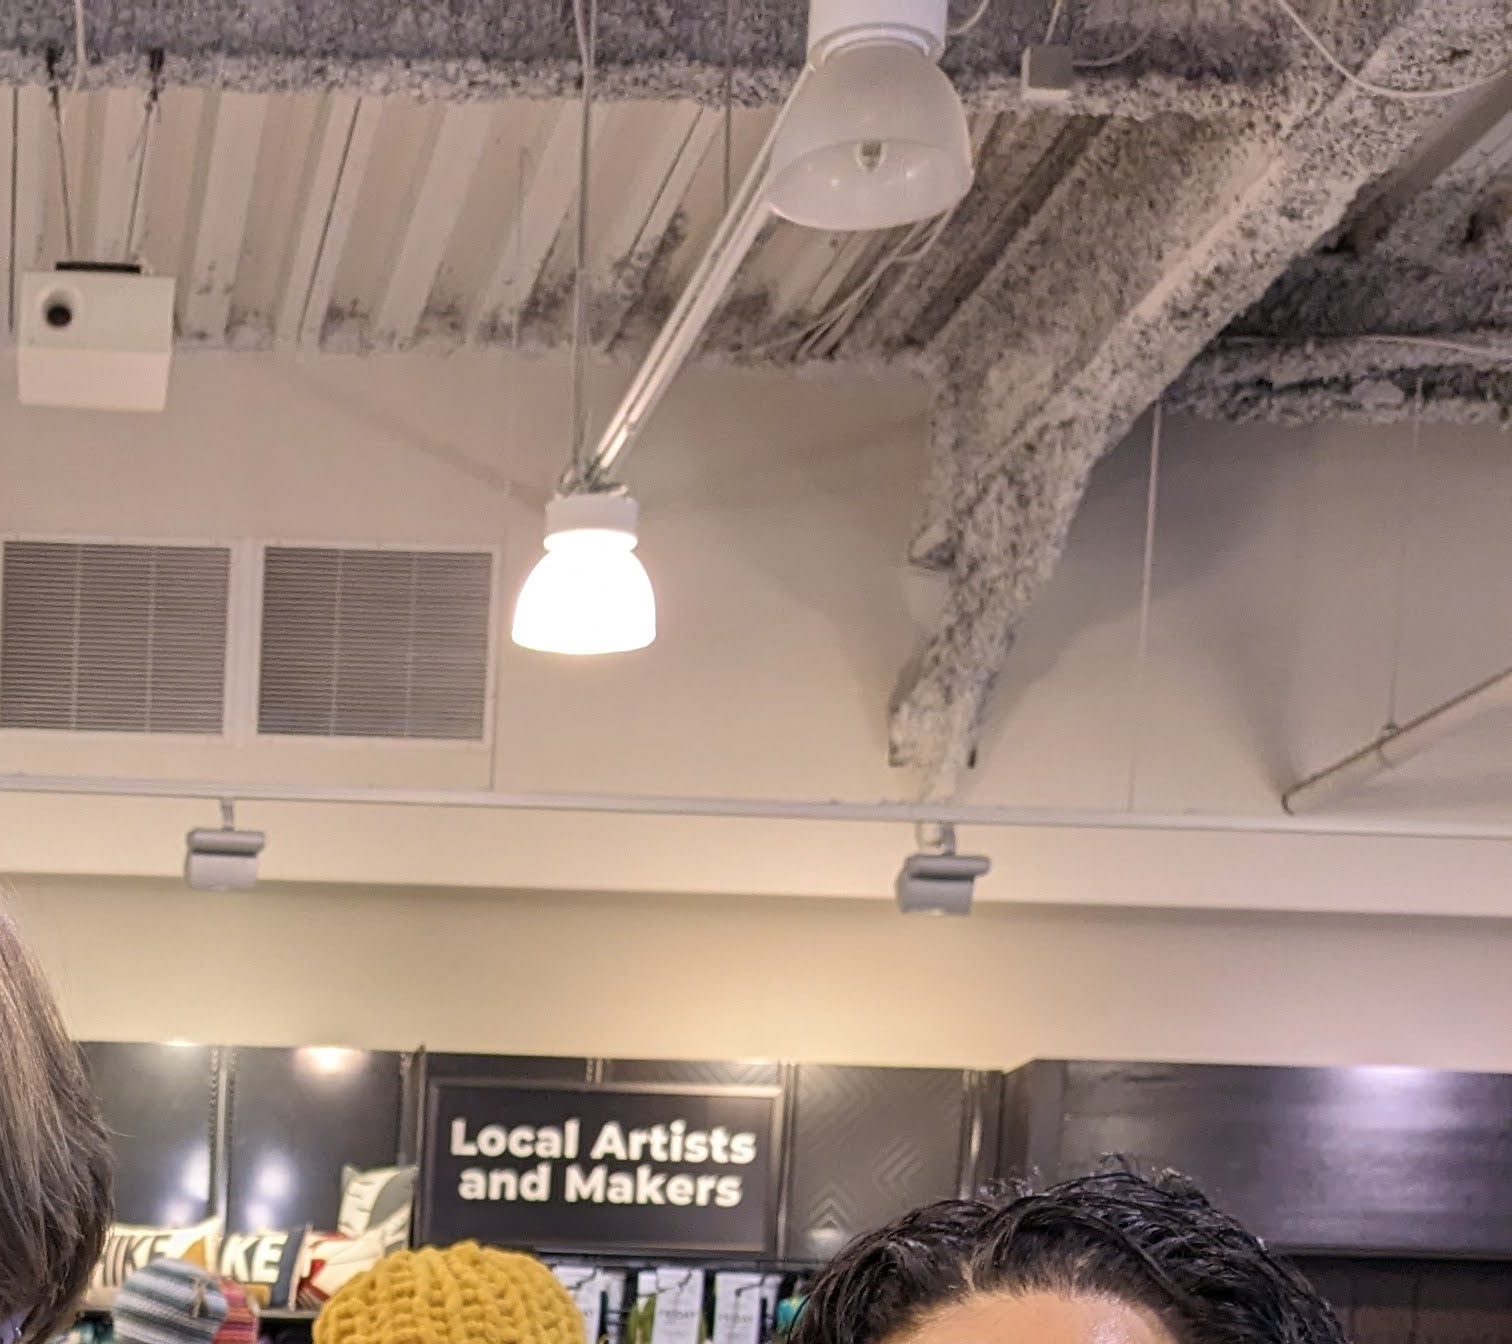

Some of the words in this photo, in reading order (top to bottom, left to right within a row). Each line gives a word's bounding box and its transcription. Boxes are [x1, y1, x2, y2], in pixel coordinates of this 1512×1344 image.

[449, 1117, 580, 1159] Local
[589, 1119, 757, 1164] Artists
[458, 1161, 552, 1202] and
[564, 1163, 743, 1207] Makers
